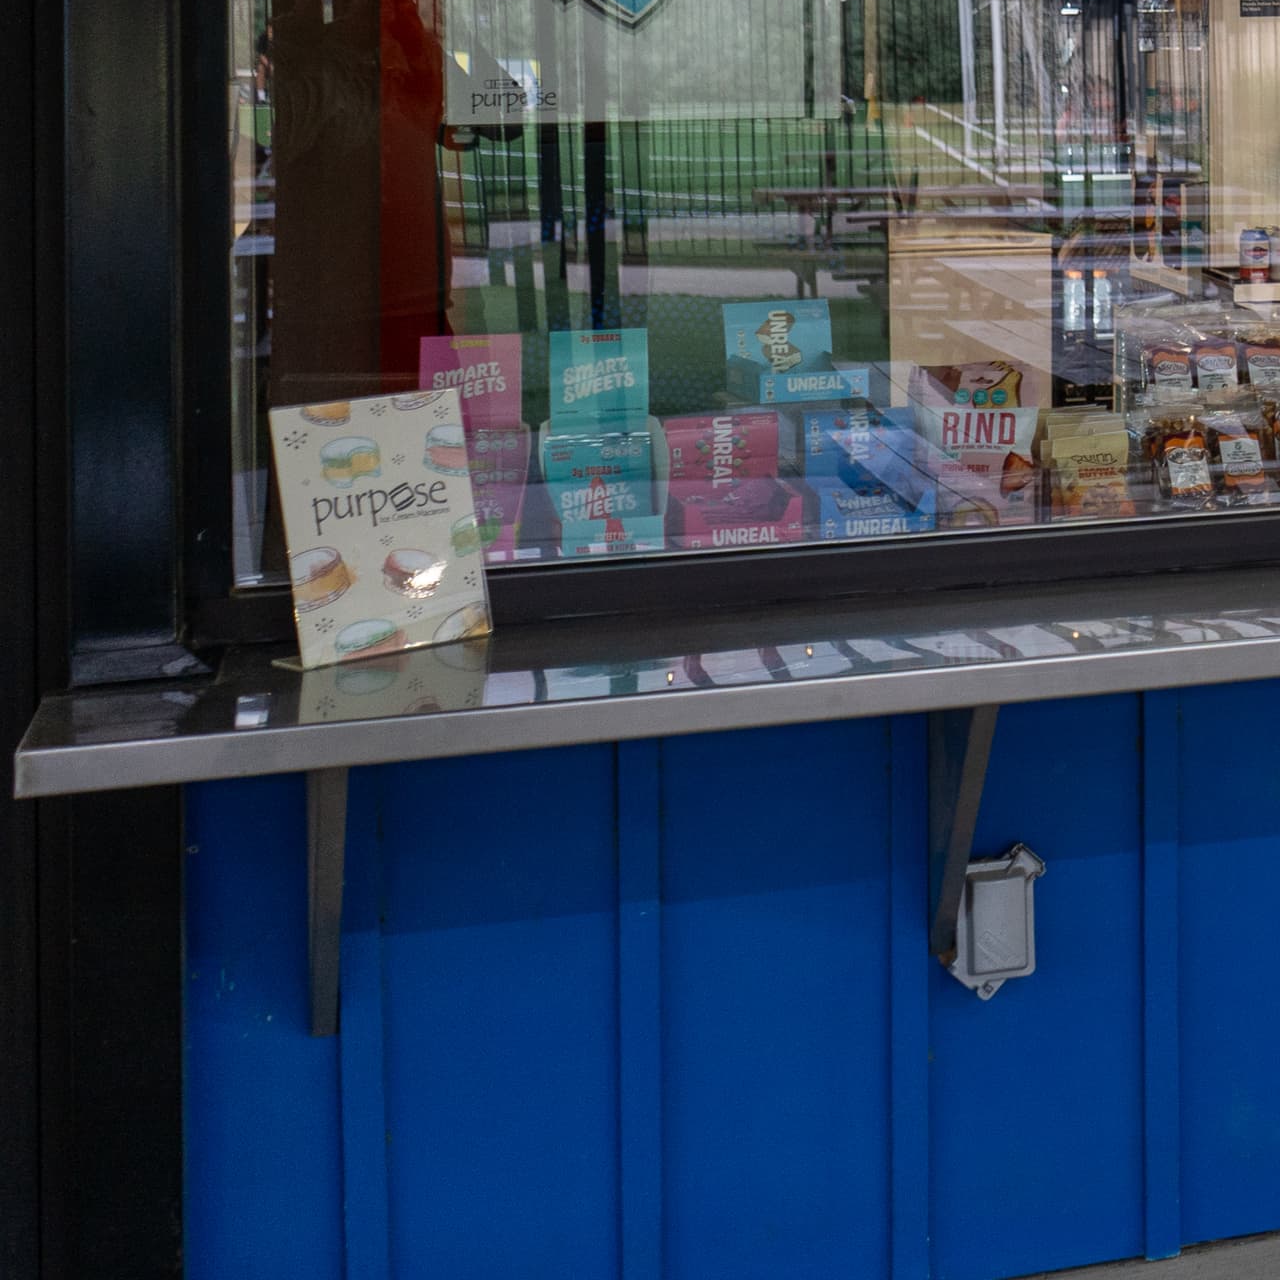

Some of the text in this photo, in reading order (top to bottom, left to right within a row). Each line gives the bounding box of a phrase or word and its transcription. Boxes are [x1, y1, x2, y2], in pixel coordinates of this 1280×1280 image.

[433, 362, 500, 390] SMART
[563, 356, 628, 383] SMART
[563, 372, 635, 404] SWEETS
[787, 376, 844, 392] UNREAL
[942, 412, 1016, 445] RIND
[712, 417, 733, 488] UNREAL
[313, 480, 447, 536] purpose
[713, 527, 778, 546] UNREAL
[845, 518, 910, 536] UNREAL
